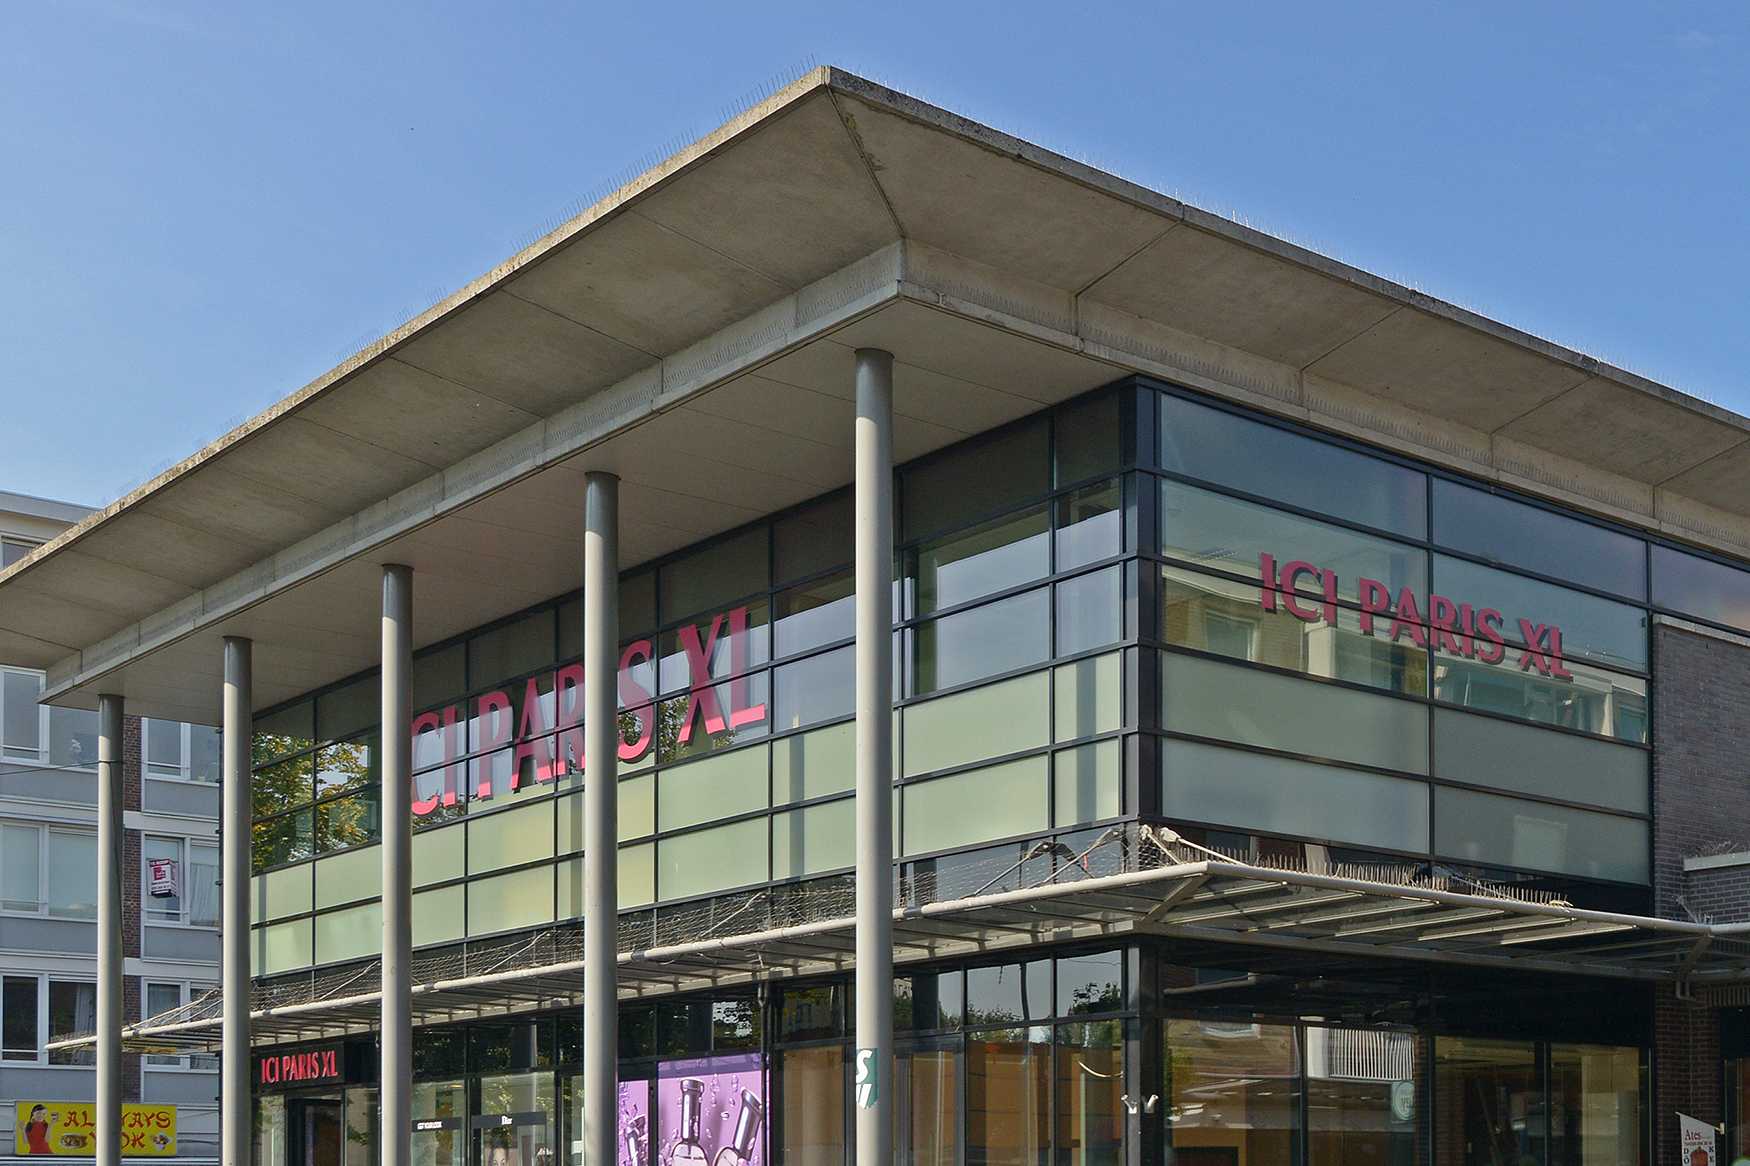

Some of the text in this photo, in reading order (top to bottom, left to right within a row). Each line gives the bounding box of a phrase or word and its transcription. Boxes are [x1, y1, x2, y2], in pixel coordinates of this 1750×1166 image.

[1260, 552, 1571, 678] ICI PARIS XL
[411, 606, 766, 816] CI PARS XL
[261, 1050, 338, 1083] ICI PARIS XL
